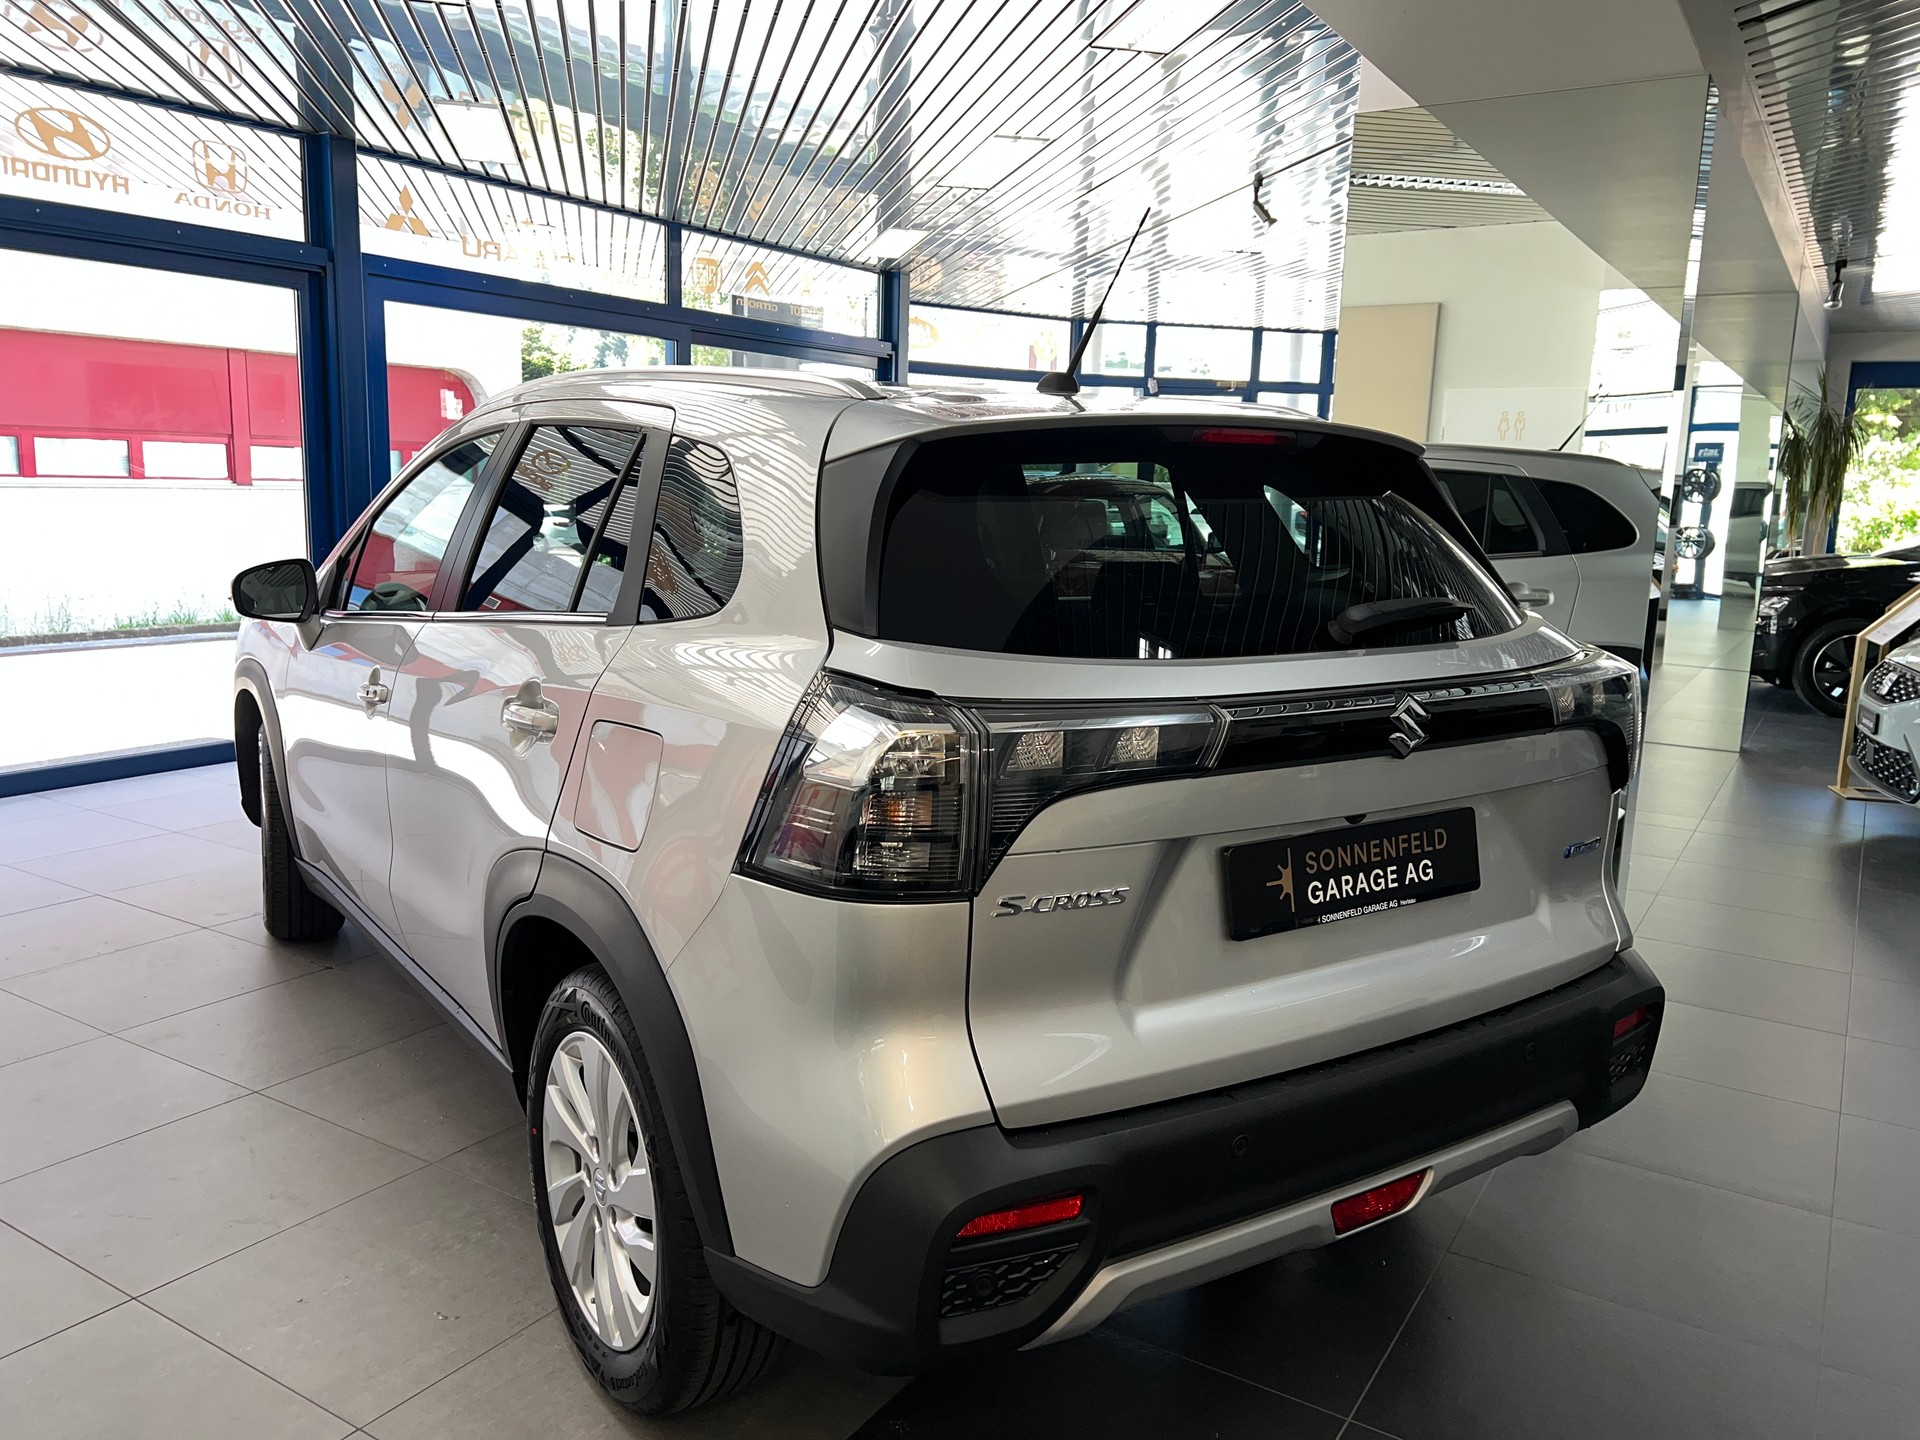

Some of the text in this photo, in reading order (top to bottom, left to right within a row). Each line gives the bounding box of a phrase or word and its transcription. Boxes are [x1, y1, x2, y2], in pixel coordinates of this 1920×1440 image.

[1305, 828, 1447, 874] SONNENFELD
[1307, 859, 1434, 904] GARAGE AG
[990, 886, 1130, 918] S-CROSS
[1321, 907, 1362, 923] SONNENFELD
[1363, 902, 1388, 914] GARAGE
[1389, 900, 1398, 909] AG
